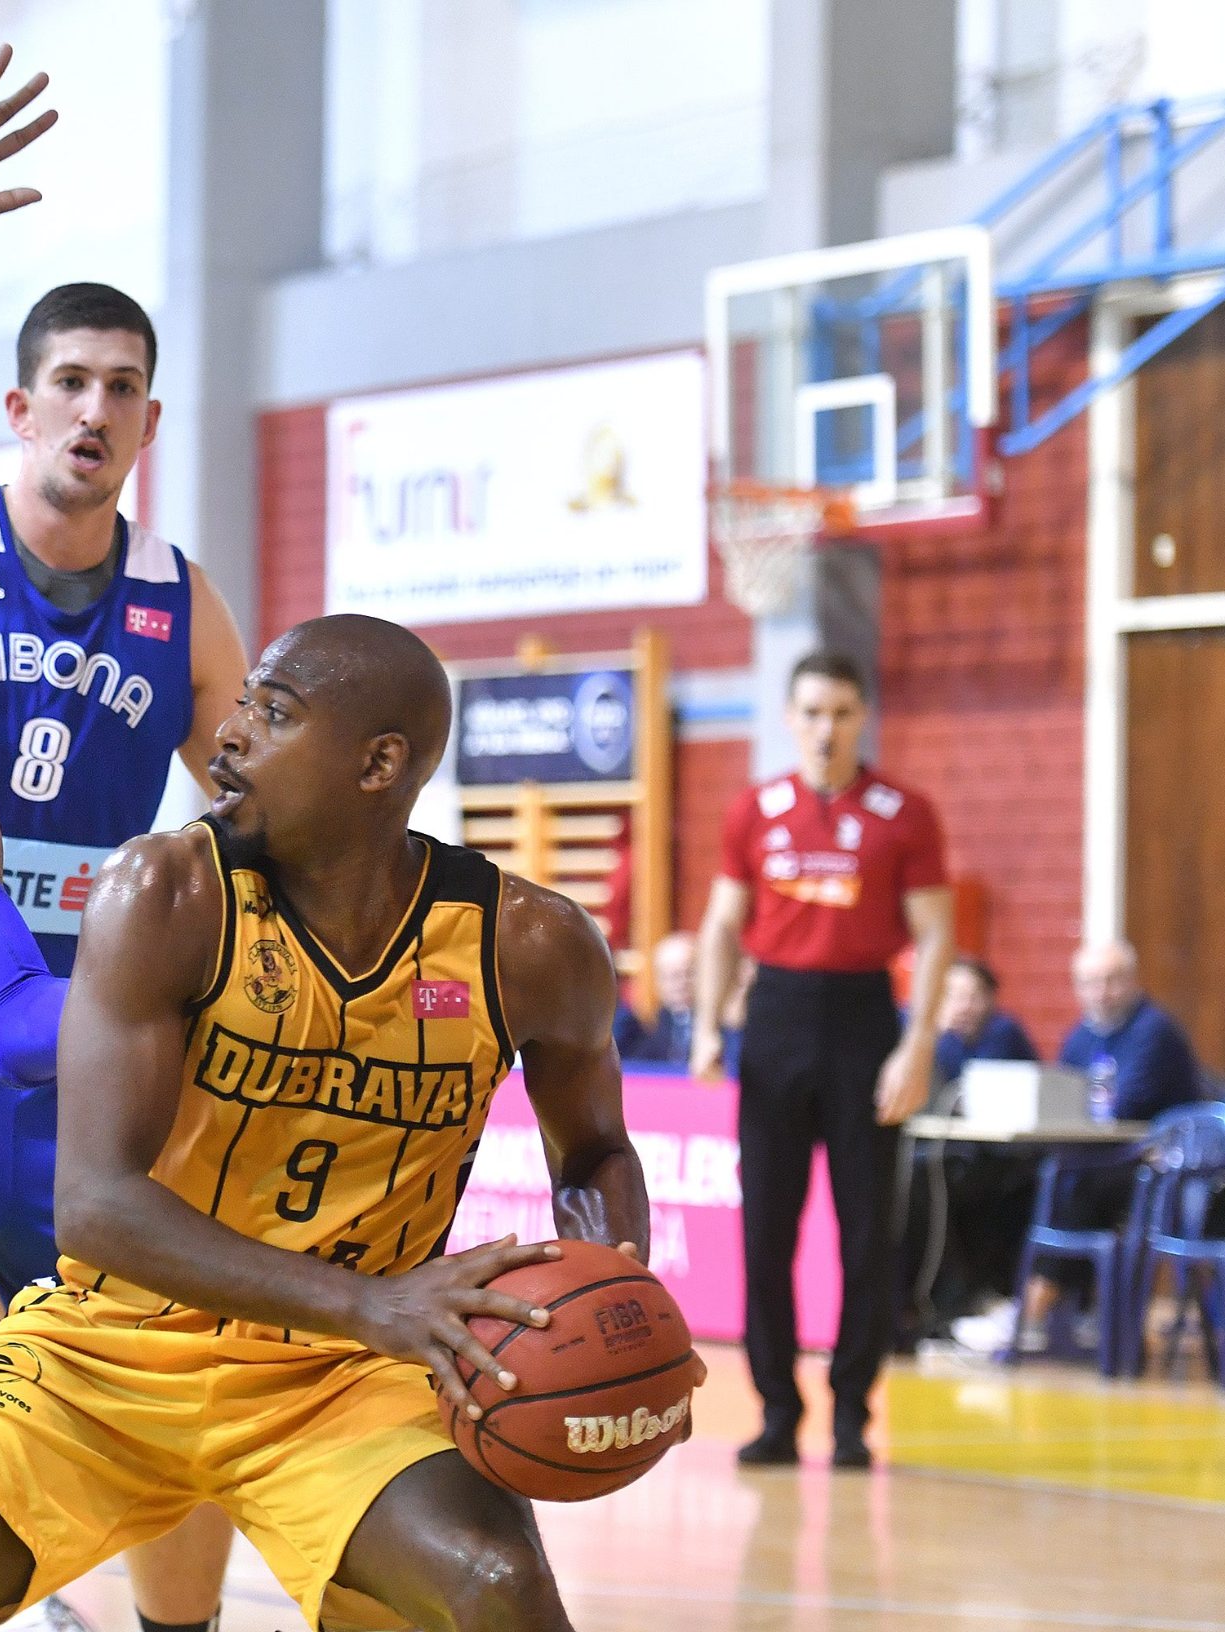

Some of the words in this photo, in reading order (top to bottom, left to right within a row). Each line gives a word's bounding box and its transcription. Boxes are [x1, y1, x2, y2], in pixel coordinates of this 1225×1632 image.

[11, 716, 71, 802] 8
[195, 1025, 473, 1130] DUBRAVA
[275, 1139, 338, 1223] 9
[595, 1299, 648, 1335] FIBA
